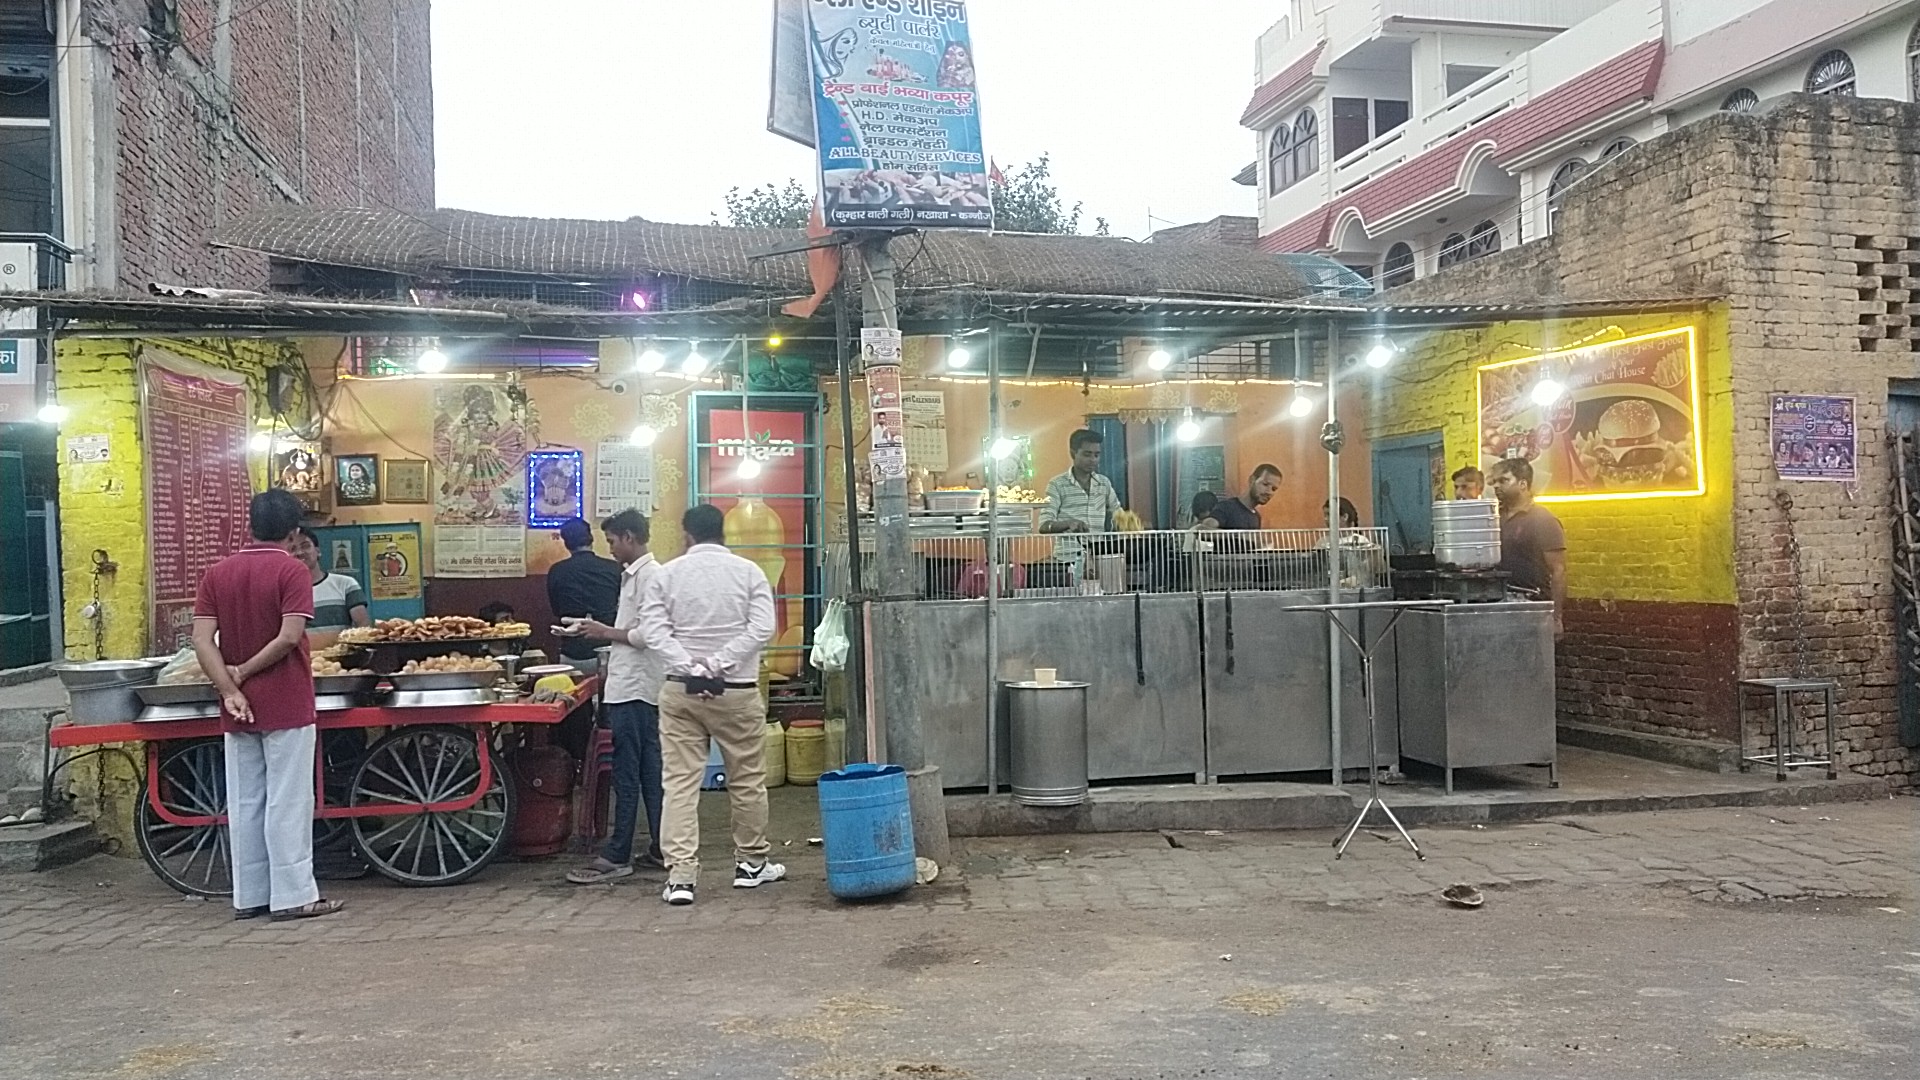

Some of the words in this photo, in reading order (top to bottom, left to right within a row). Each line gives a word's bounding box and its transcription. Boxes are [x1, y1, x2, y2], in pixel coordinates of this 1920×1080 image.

[858, 14, 896, 35] ब्यूटी
[903, 19, 941, 38] पार्लर
[894, 86, 929, 100] भव्या
[933, 91, 972, 105] कपूर
[861, 111, 889, 121] H.D.
[893, 112, 938, 126] मेकअप
[830, 147, 859, 158] ALL
[861, 149, 914, 161] BEAUTY
[917, 150, 981, 163] SERVICES
[882, 161, 904, 171] होम
[867, 208, 888, 220] वाली
[891, 208, 914, 222] गली)
[1657, 336, 1684, 351] Food
[1595, 371, 1615, 385] Chat
[1617, 366, 1646, 379] House
[173, 611, 193, 624] NIT
